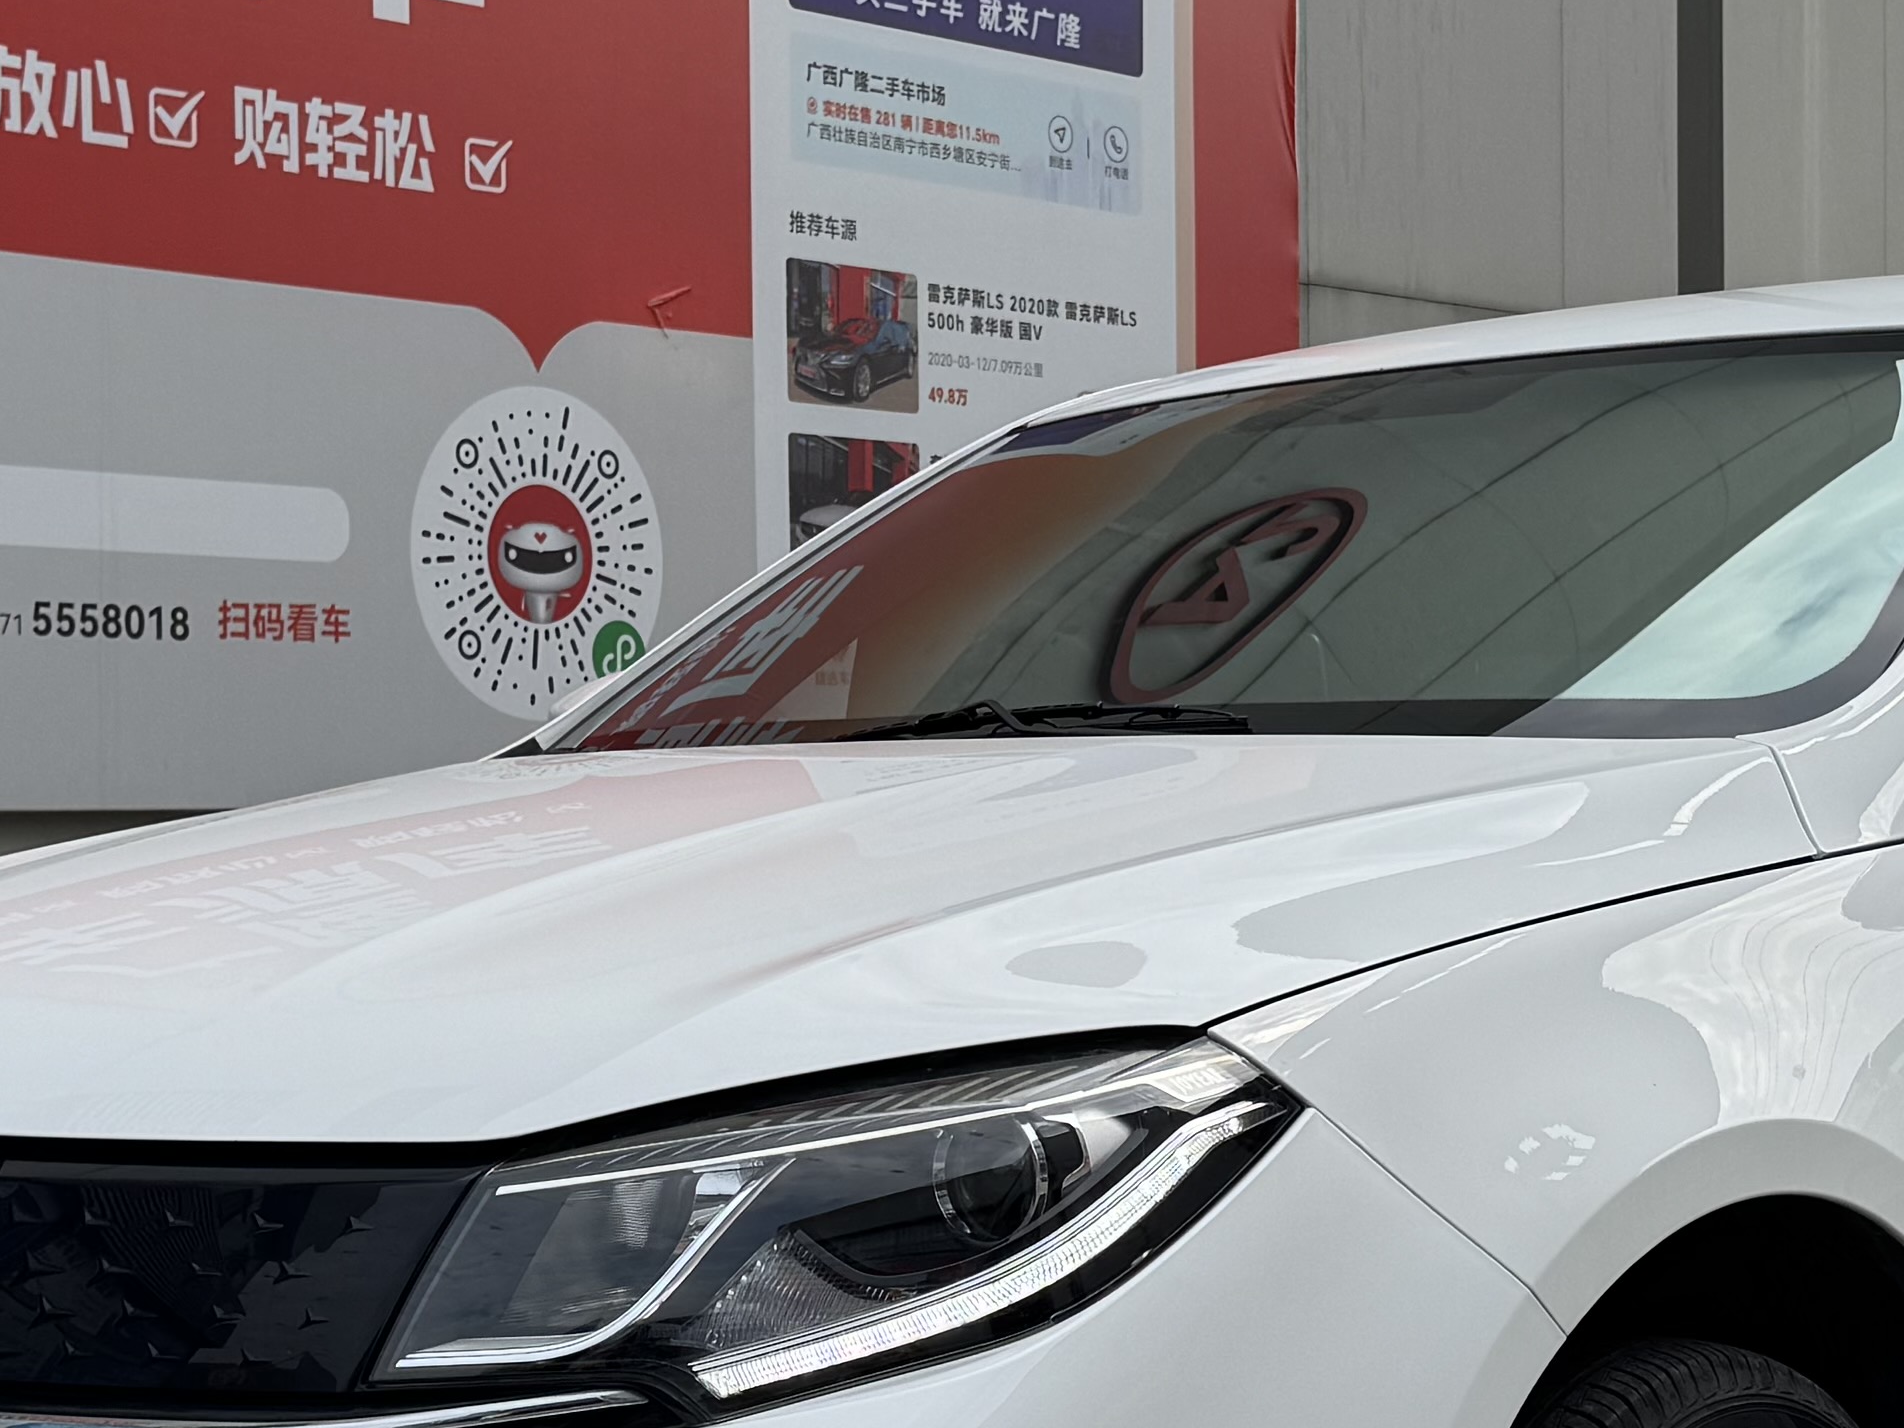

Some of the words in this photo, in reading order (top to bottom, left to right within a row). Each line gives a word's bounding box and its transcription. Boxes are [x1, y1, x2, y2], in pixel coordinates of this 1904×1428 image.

[806, 61, 947, 107] 广西广隆二手车市场
[822, 99, 872, 125] 实时在售
[875, 110, 896, 128] 281
[233, 85, 435, 193] 购轻松
[789, 210, 858, 243] 推荐车源
[927, 283, 1004, 310] 雷克萨斯LS
[1009, 295, 1059, 319] 2020款
[1064, 301, 1138, 328] 雷克萨斯LS
[927, 312, 965, 333] 500h
[970, 315, 1013, 340] 豪华版
[1018, 321, 1043, 341] 国V
[927, 351, 1044, 378] 2020-03-12/7.09万公里
[927, 386, 969, 407] 49.8万
[32, 600, 190, 642] 5558018
[218, 600, 352, 644] 扫码看车
